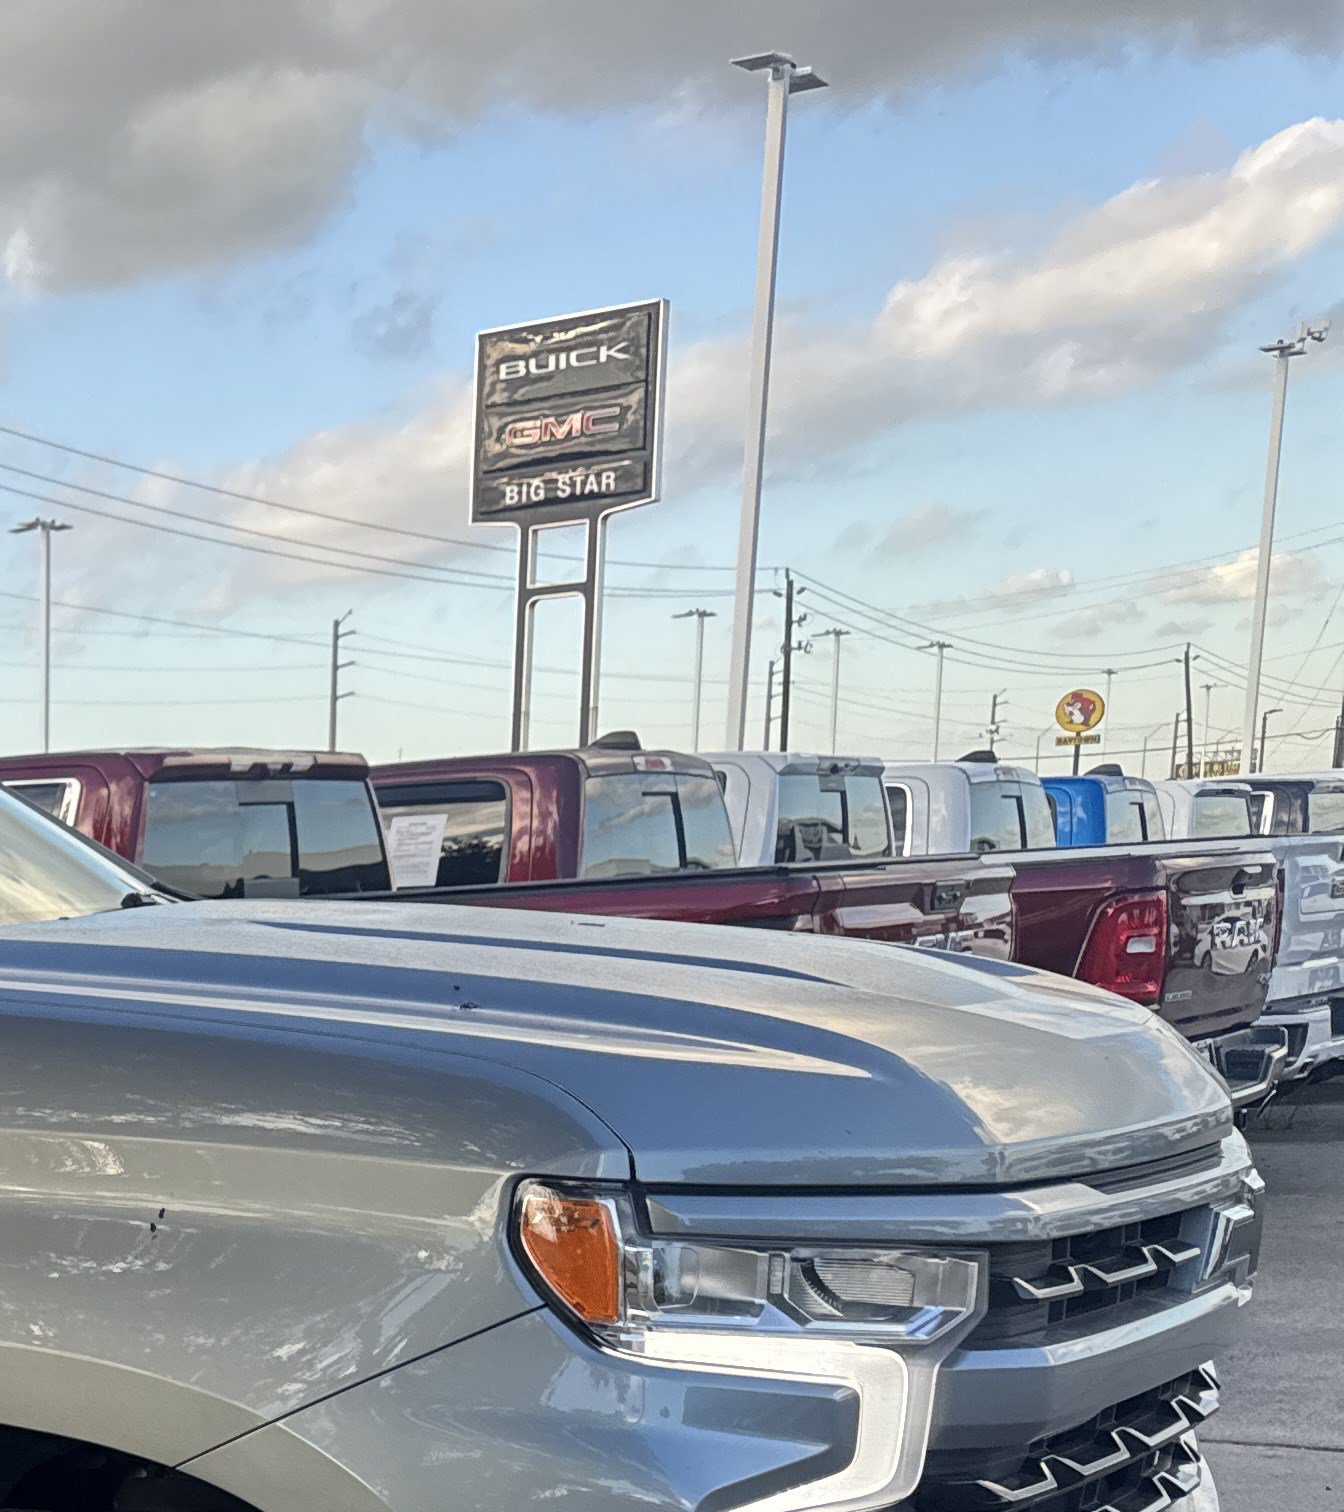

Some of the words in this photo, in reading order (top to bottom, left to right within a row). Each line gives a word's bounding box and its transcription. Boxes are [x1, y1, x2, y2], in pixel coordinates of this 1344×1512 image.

[498, 341, 631, 381] BUICK
[504, 406, 620, 447] GMC
[504, 478, 545, 505] BIG
[556, 472, 616, 498] STAR
